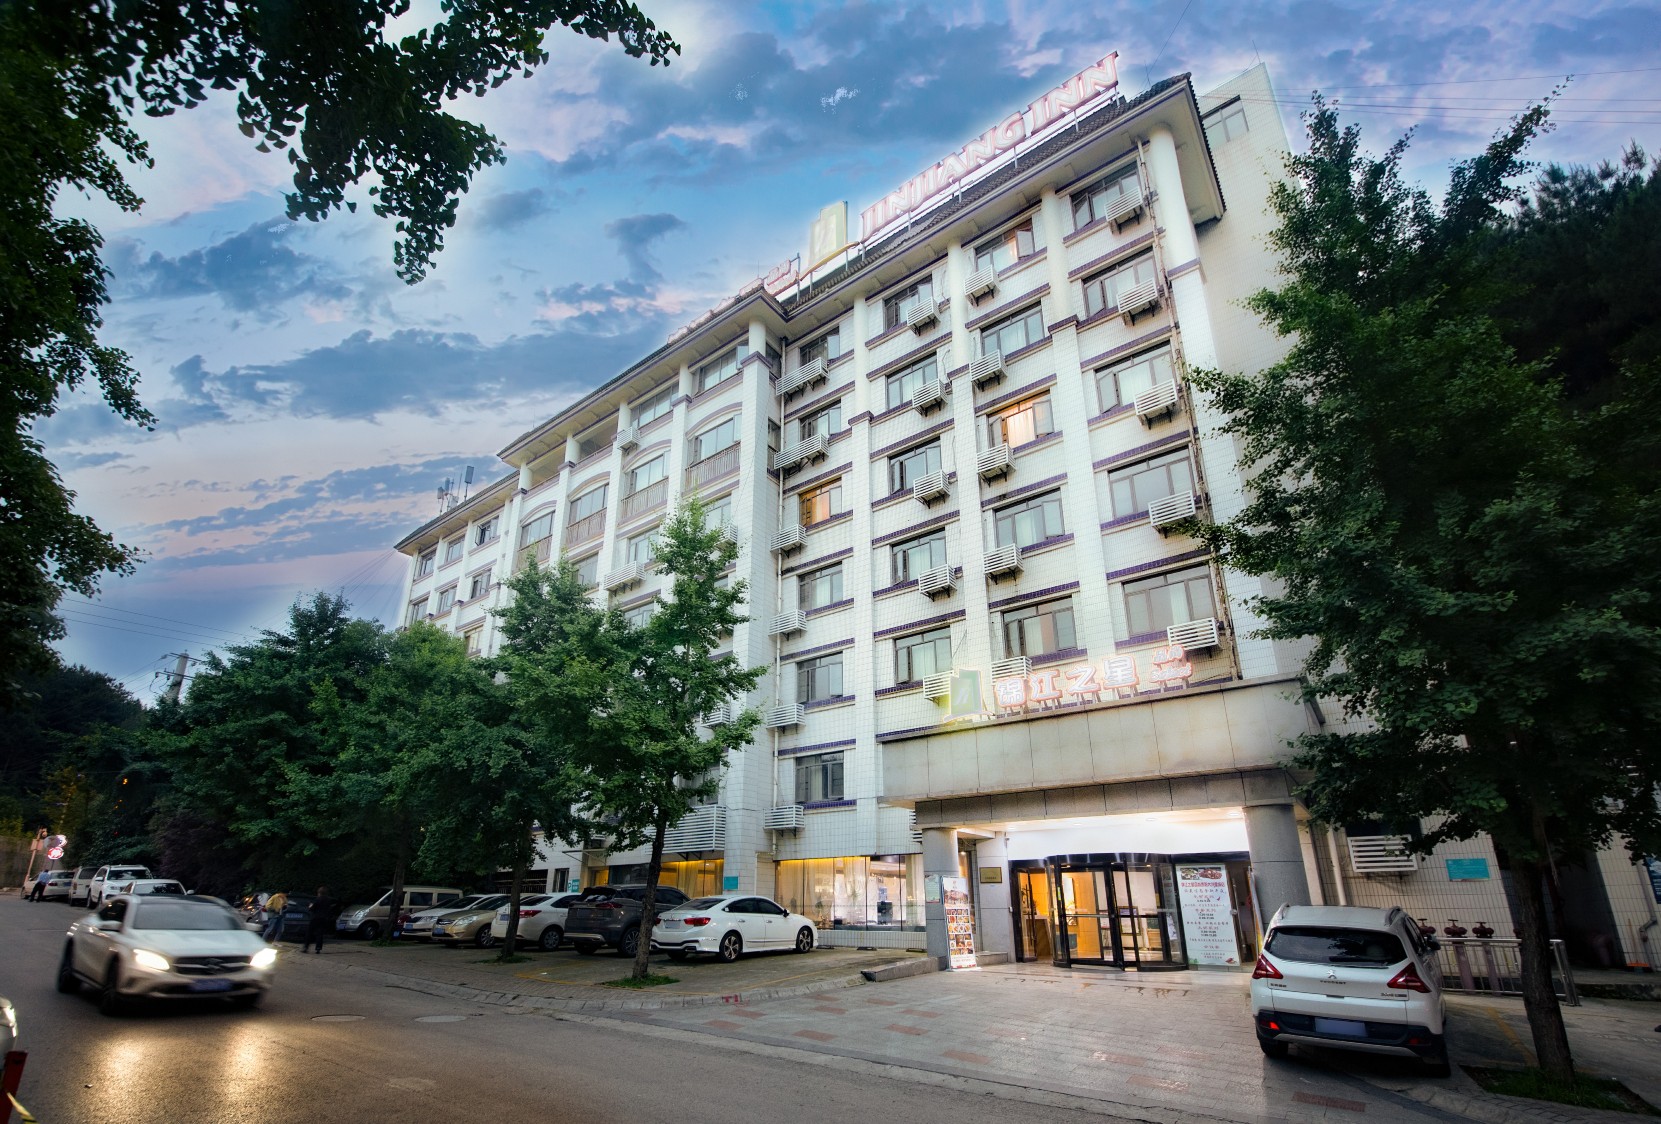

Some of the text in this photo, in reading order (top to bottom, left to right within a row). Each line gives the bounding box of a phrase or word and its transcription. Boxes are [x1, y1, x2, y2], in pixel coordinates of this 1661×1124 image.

[861, 50, 1119, 243] JINJIANG INN
[994, 654, 1138, 706] 锦江之星
